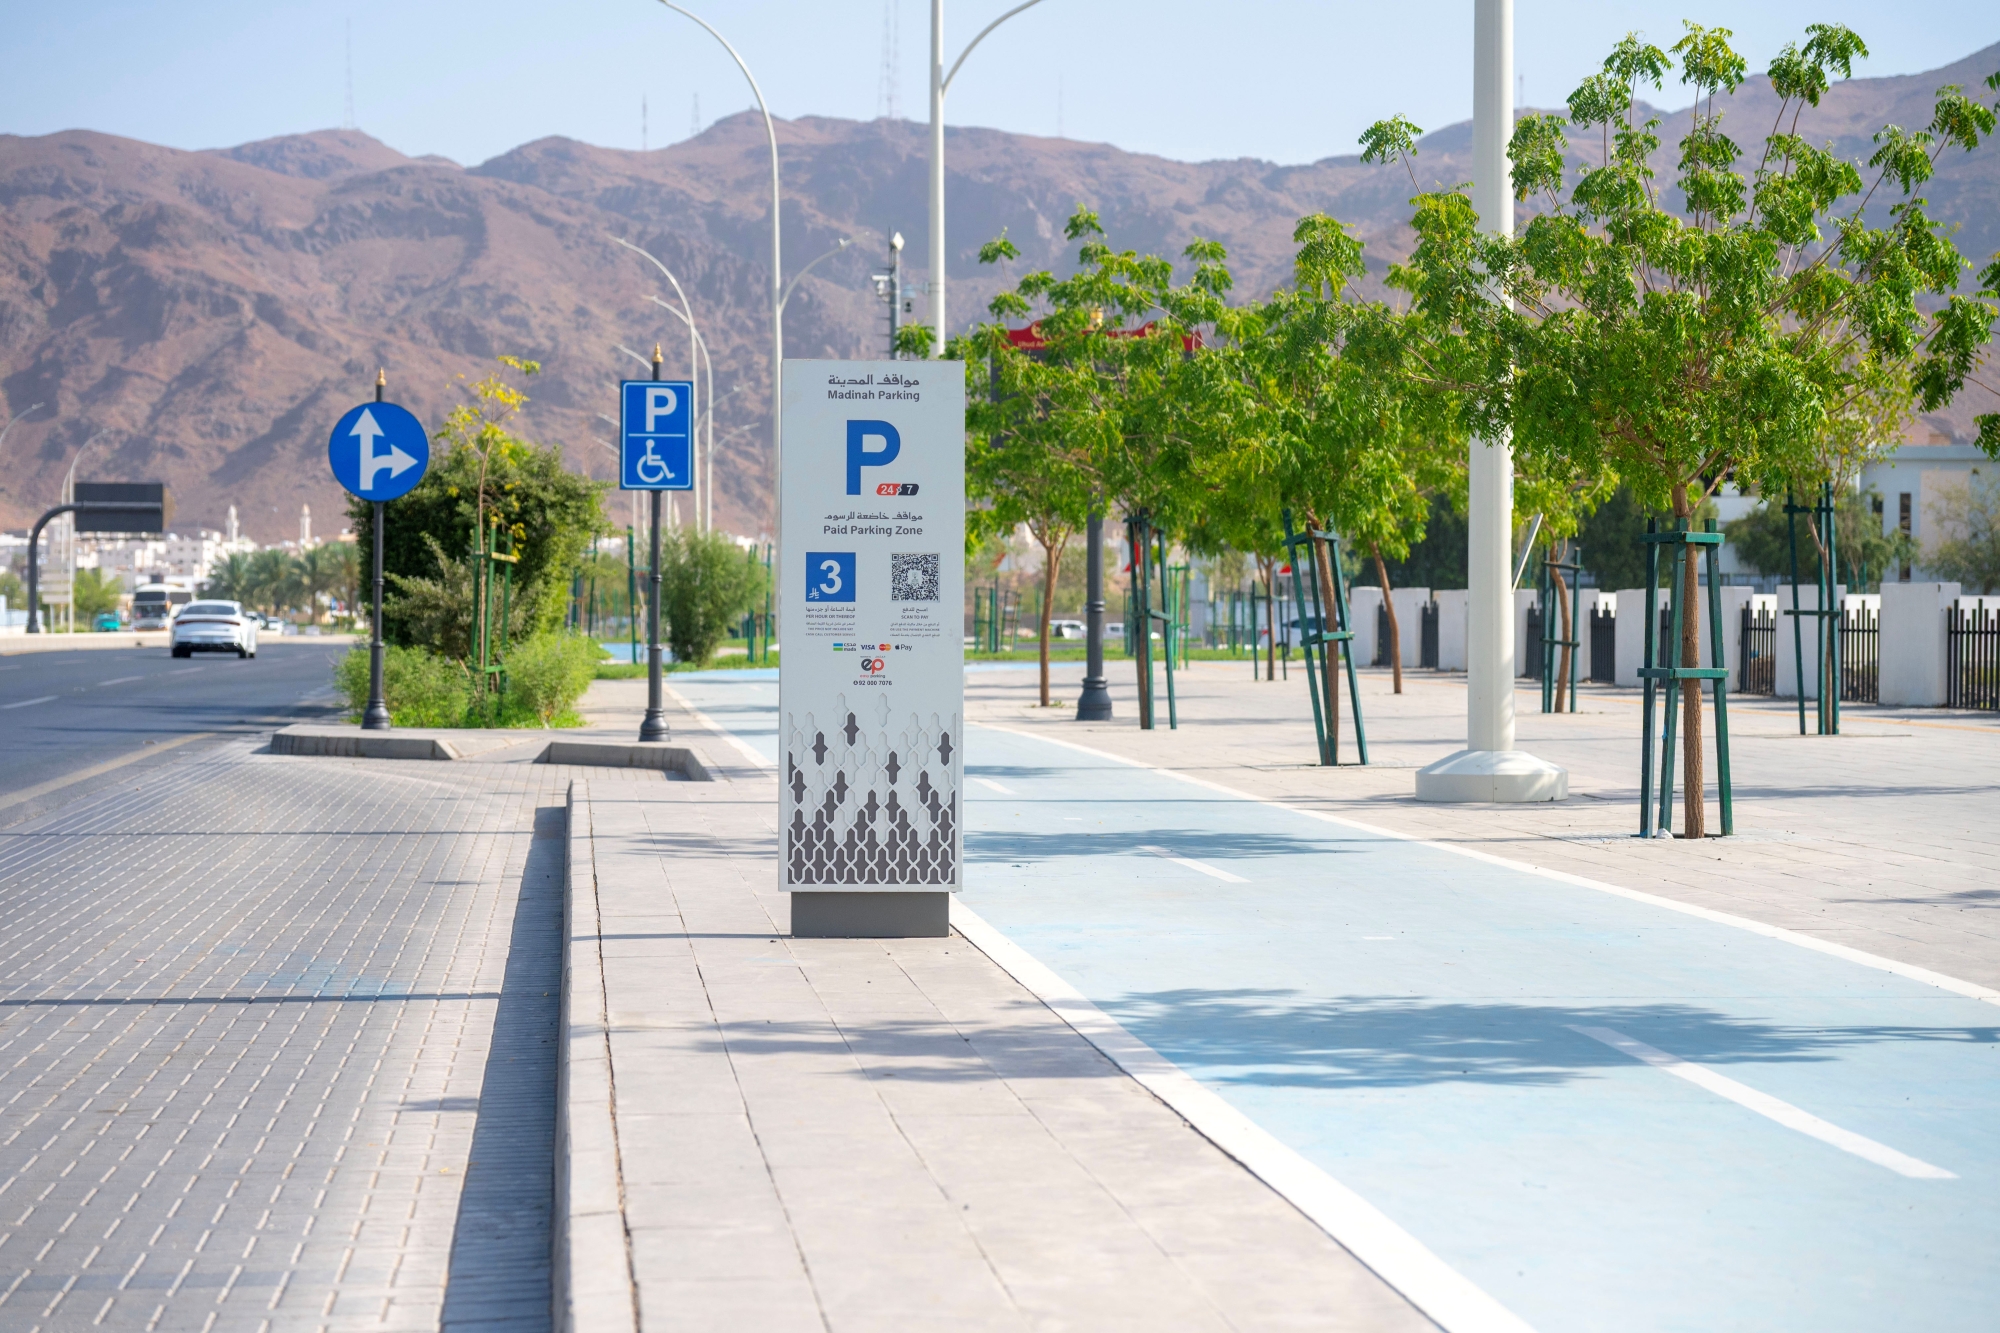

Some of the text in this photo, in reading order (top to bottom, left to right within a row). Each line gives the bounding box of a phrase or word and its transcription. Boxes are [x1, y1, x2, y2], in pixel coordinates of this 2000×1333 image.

[828, 374, 920, 387] مواقف المدينة
[828, 390, 920, 402] Madinah Parking
[646, 388, 677, 432] P
[846, 420, 900, 495] P
[824, 512, 923, 522] مواقف خاضعة للرسوم
[824, 525, 922, 537] Paid Parking Zone
[820, 560, 842, 594] 3
[861, 658, 884, 674] ep
